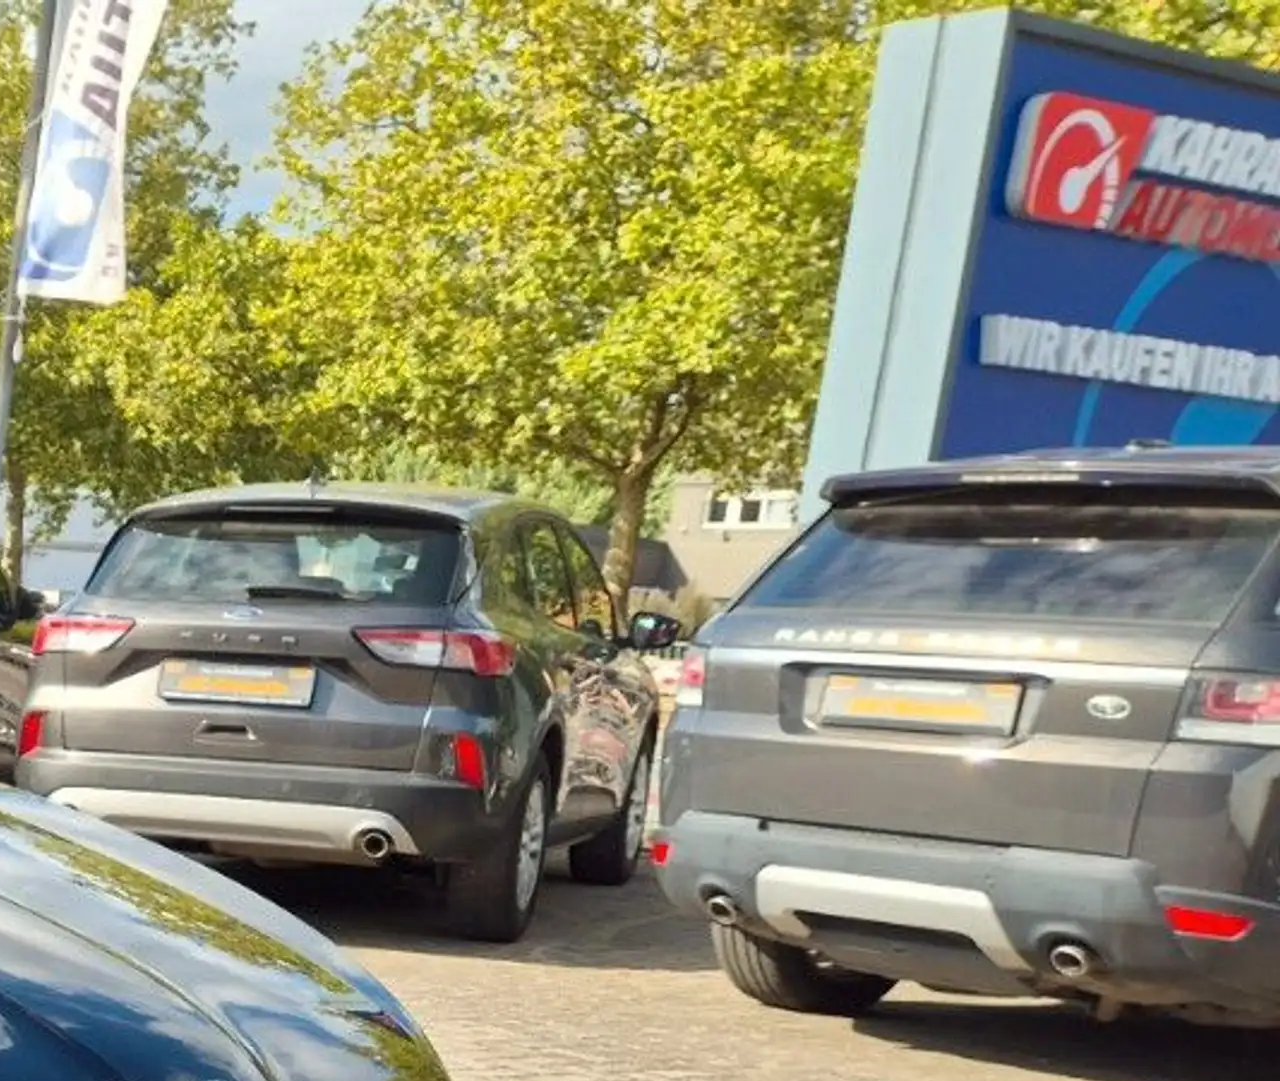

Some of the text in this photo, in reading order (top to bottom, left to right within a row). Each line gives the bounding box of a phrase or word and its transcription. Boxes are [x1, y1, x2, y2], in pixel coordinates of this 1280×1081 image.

[982, 313, 1064, 374] WIR
[1065, 325, 1198, 392] KAUFEN
[1195, 344, 1255, 400] IHR
